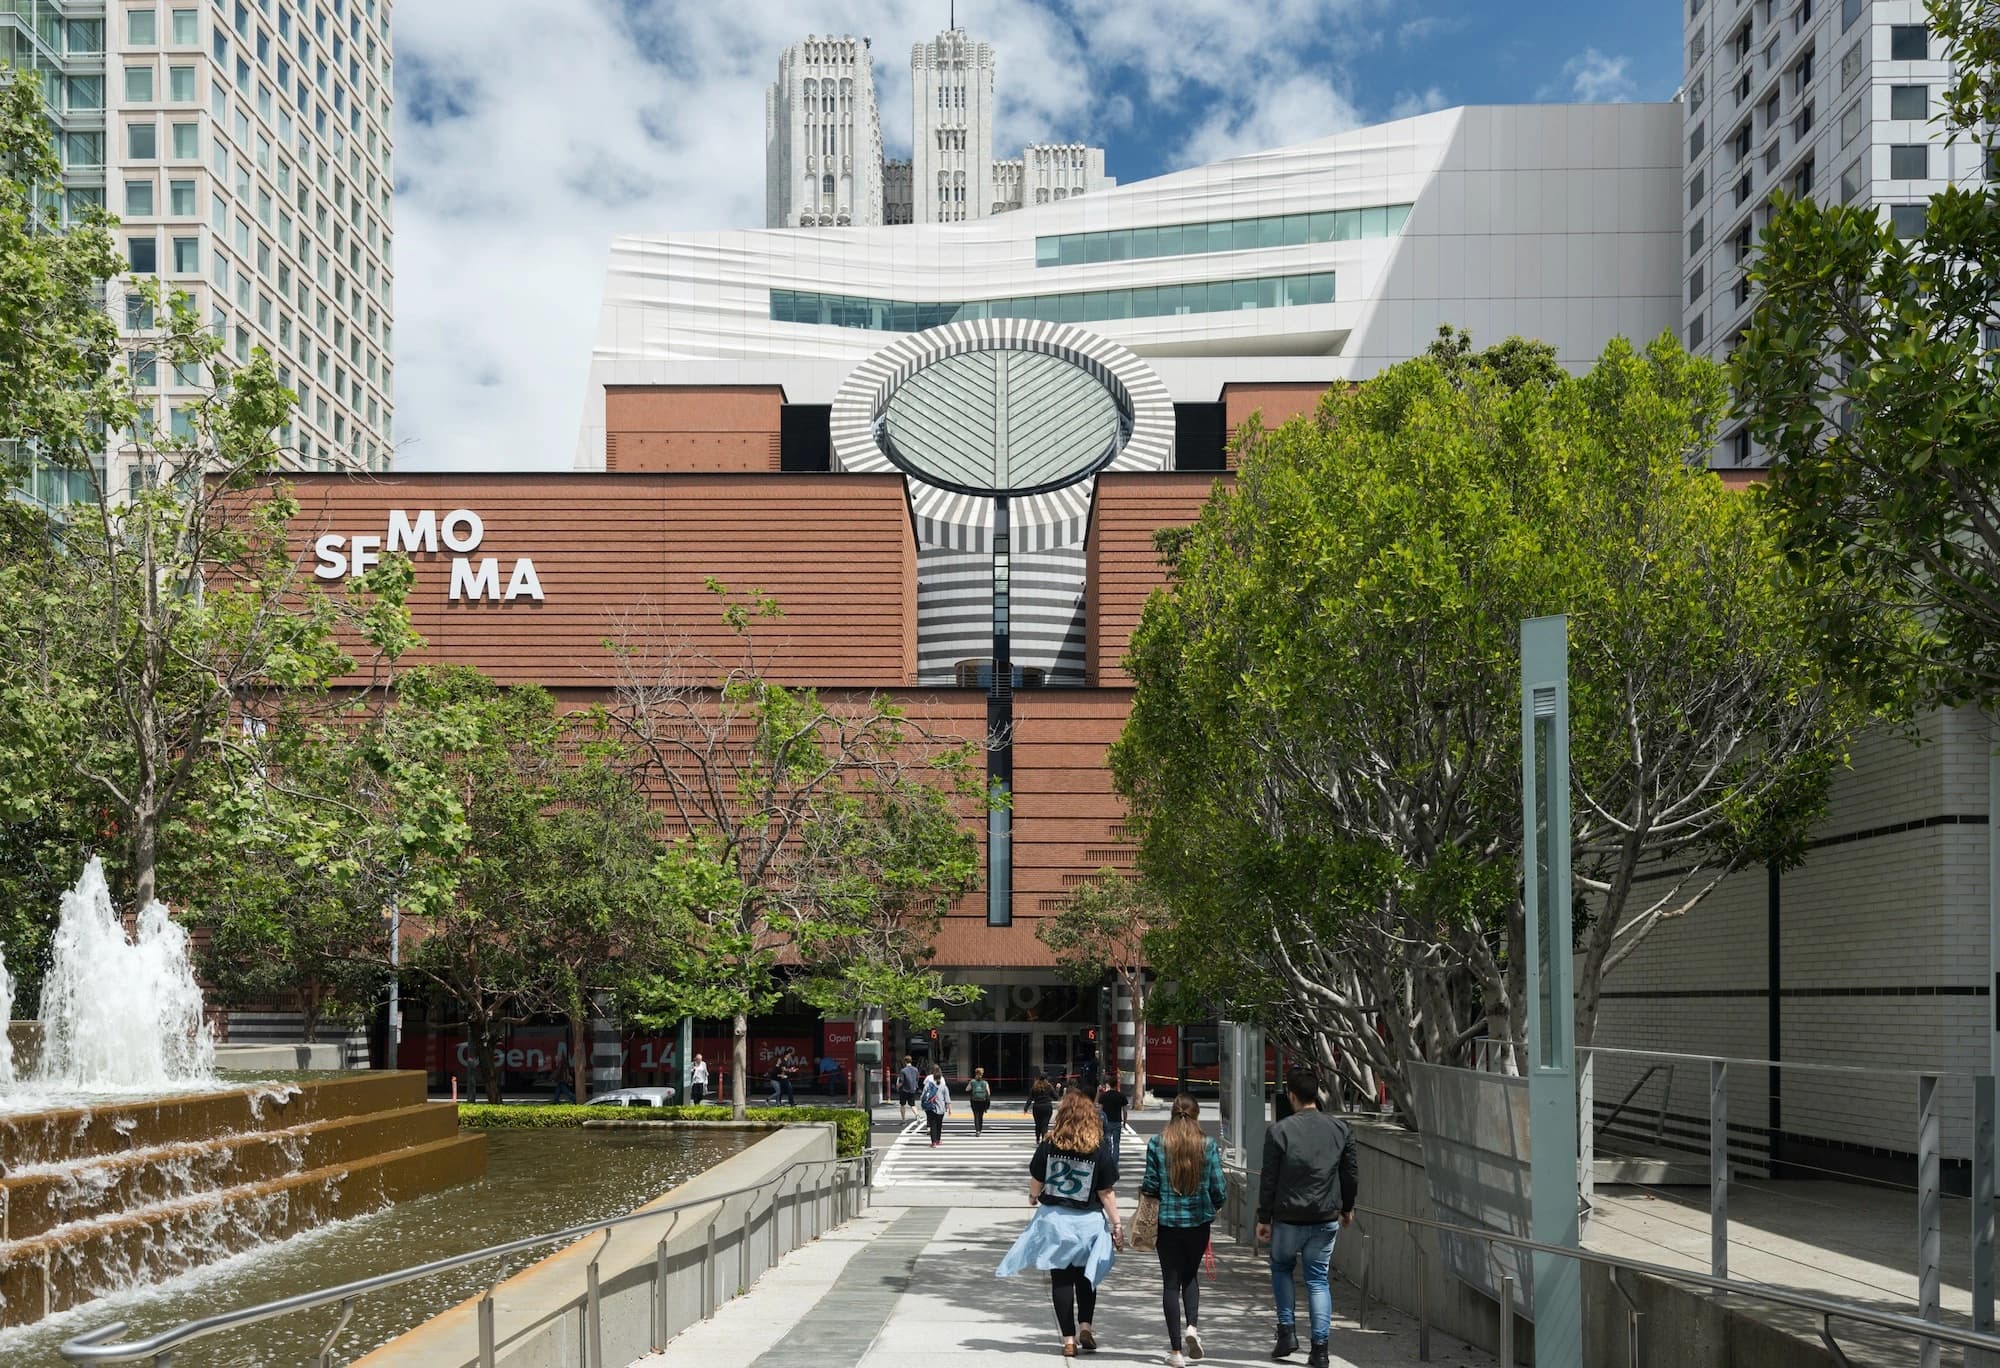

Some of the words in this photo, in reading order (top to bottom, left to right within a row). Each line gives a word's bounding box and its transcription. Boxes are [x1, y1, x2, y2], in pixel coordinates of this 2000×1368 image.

[386, 509, 484, 552] MO
[314, 534, 381, 579] SF
[448, 557, 545, 600] MA
[639, 1041, 677, 1069] 14
[828, 1033, 852, 1046] Open
[1145, 1035, 1159, 1047] ay
[1161, 1036, 1173, 1045] 14
[1046, 1160, 1090, 1195] 25
